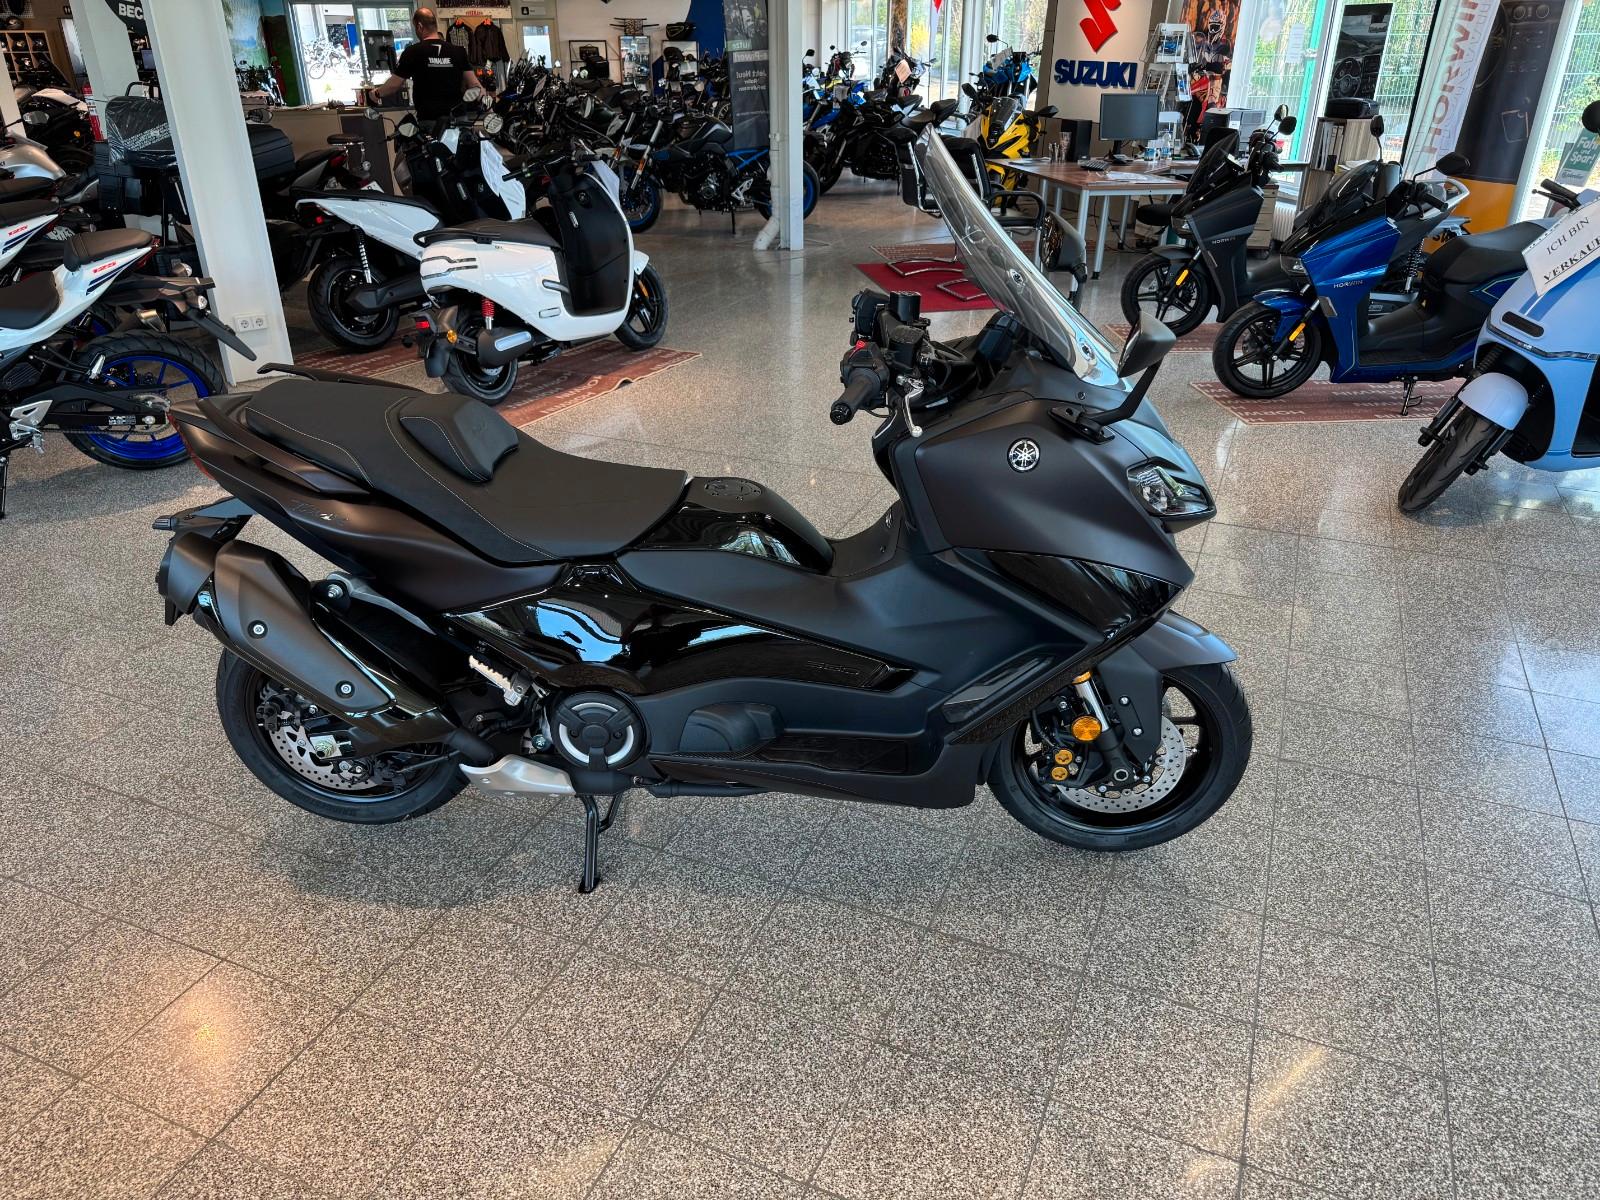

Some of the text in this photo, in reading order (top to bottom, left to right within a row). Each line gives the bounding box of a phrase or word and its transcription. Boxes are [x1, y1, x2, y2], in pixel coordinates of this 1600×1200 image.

[1054, 58, 1138, 89] SUZUKI
[1570, 151, 1596, 164] Spar!
[8, 225, 28, 236] 125
[1546, 217, 1590, 255] ICH BIN
[92, 261, 117, 274] 125
[1333, 280, 1364, 288] HORWIN
